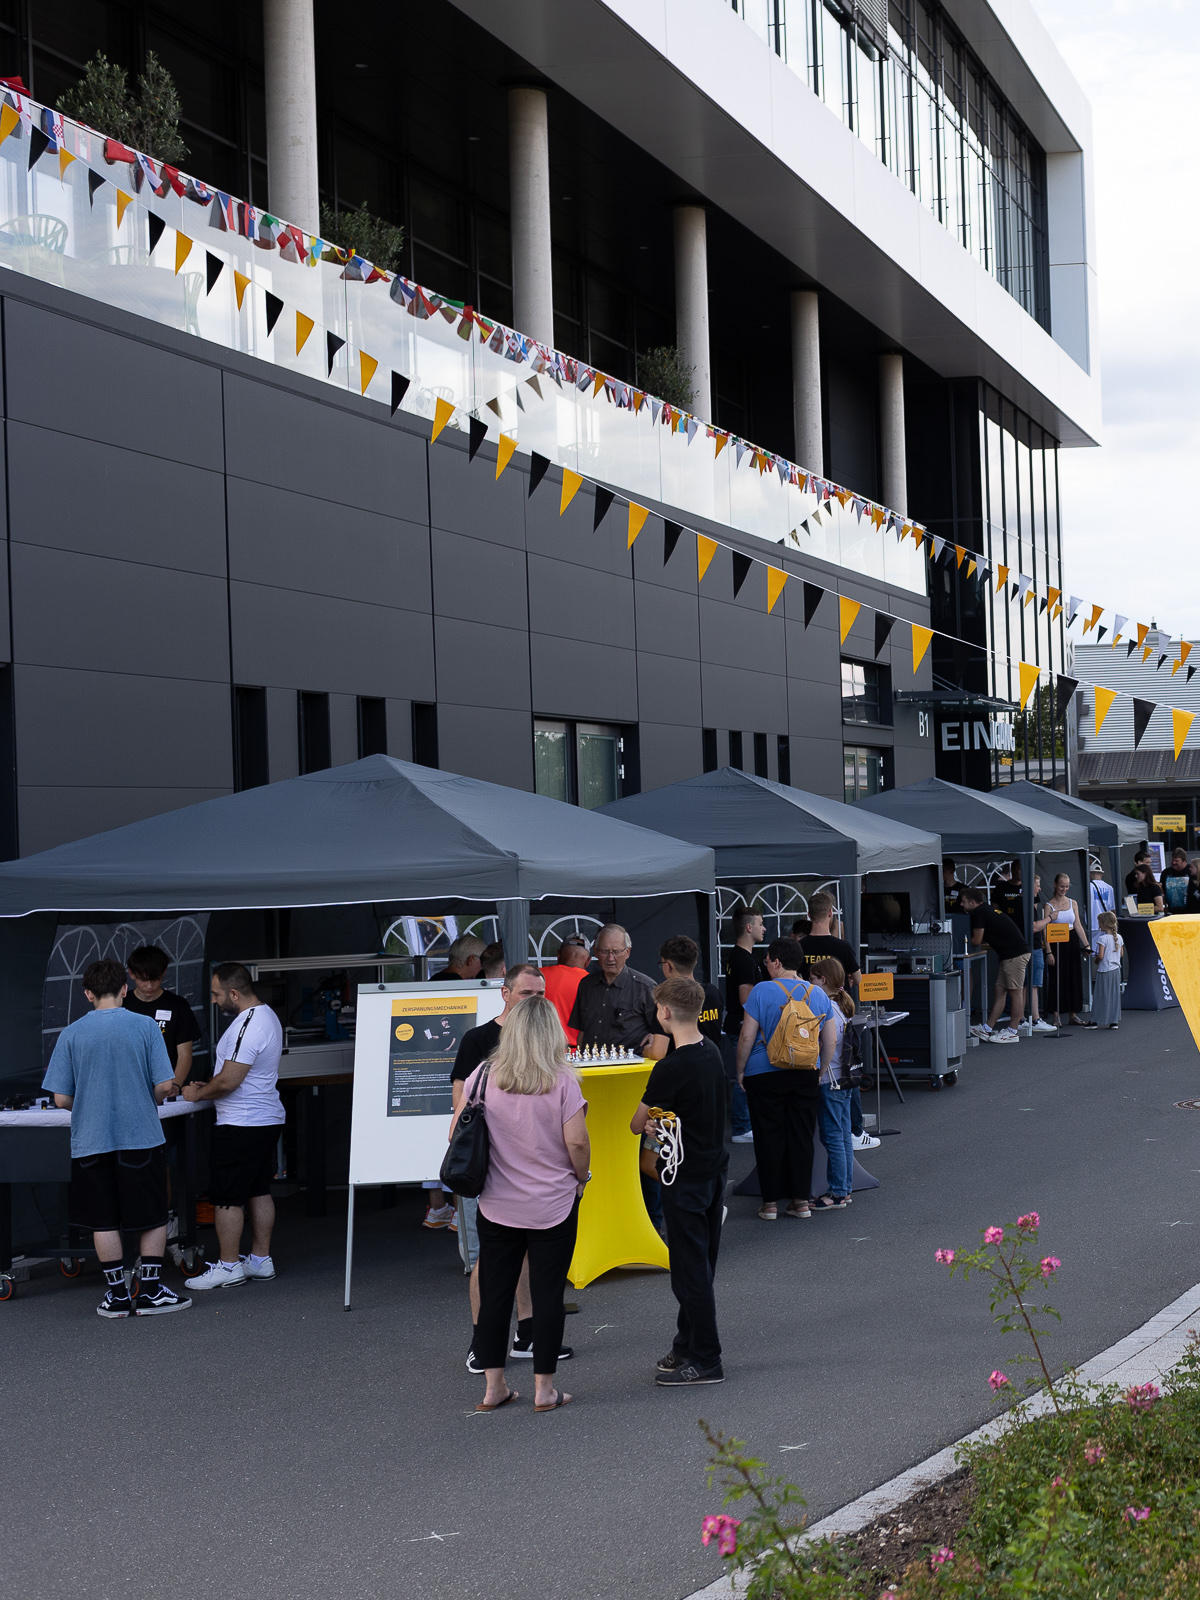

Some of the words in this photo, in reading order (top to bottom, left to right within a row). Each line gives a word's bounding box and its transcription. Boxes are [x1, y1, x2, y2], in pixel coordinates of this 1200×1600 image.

[918, 711, 929, 738] B1
[941, 721, 1016, 752] EINGANG
[698, 1008, 719, 1023] EAM
